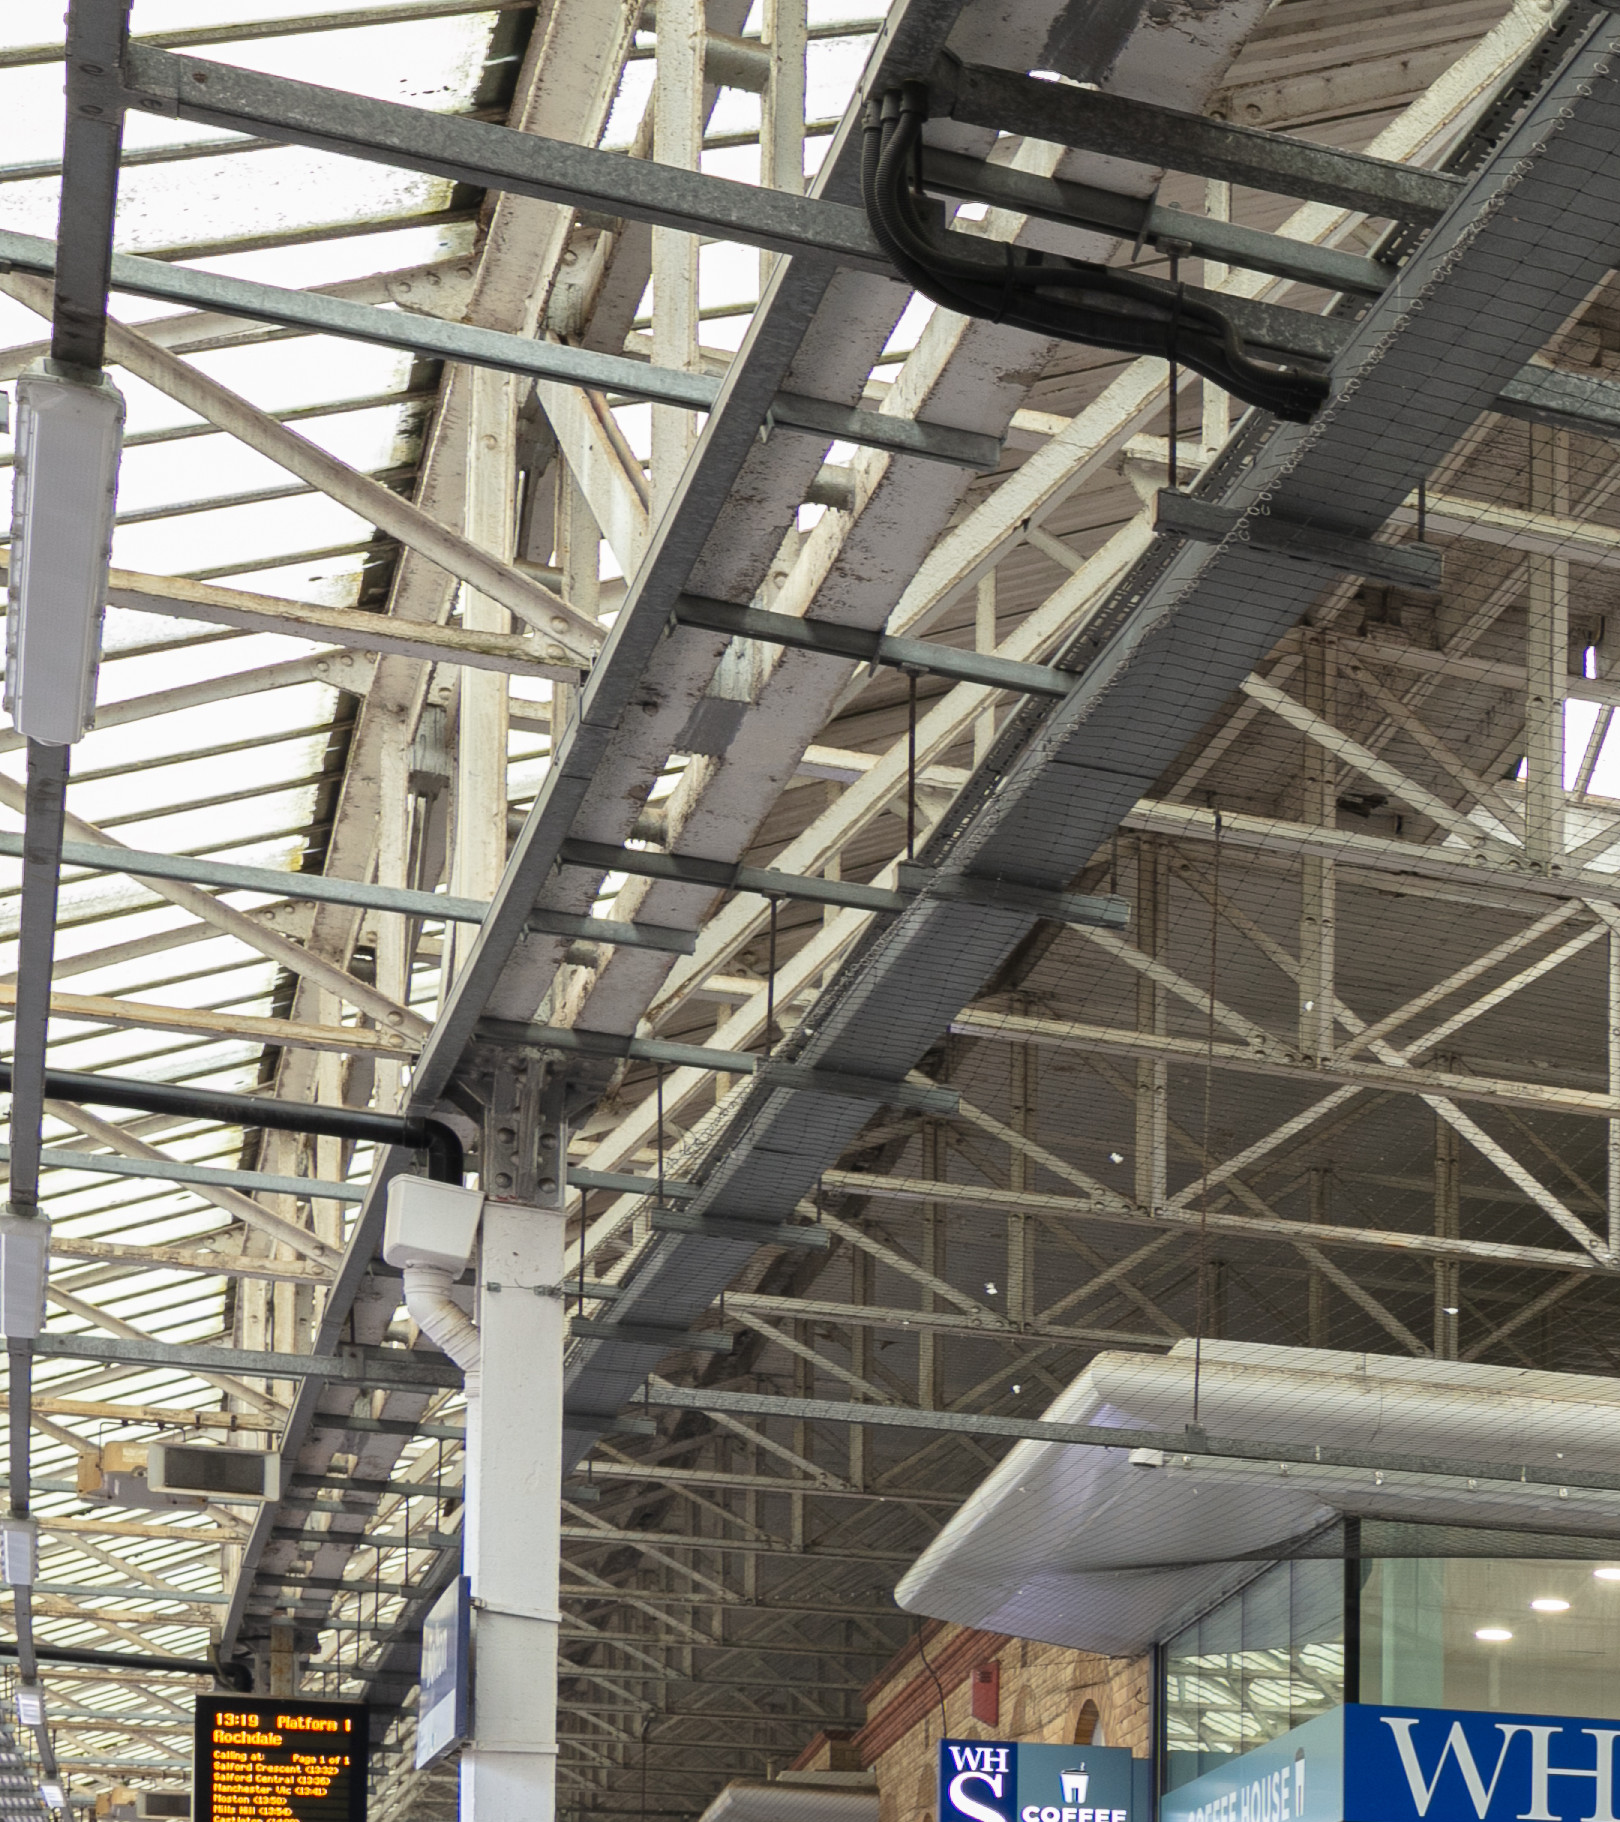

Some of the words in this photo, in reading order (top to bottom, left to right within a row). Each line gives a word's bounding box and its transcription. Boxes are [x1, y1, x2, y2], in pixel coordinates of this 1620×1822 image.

[216, 1713, 259, 1727] 13:19
[277, 1716, 338, 1731] Platform
[344, 1719, 351, 1732] 1
[213, 1729, 282, 1746] Rochdale
[213, 1750, 247, 1761] Calling
[292, 1754, 316, 1764] Page
[329, 1756, 341, 1764] of
[949, 1746, 1009, 1773] WH
[213, 1761, 252, 1771] Salford
[255, 1763, 301, 1773] Crescent
[213, 1772, 252, 1782] Salford
[255, 1775, 294, 1784] Central
[213, 1783, 272, 1794] Manchester
[213, 1794, 249, 1804] Moston
[213, 1805, 236, 1814] Mills
